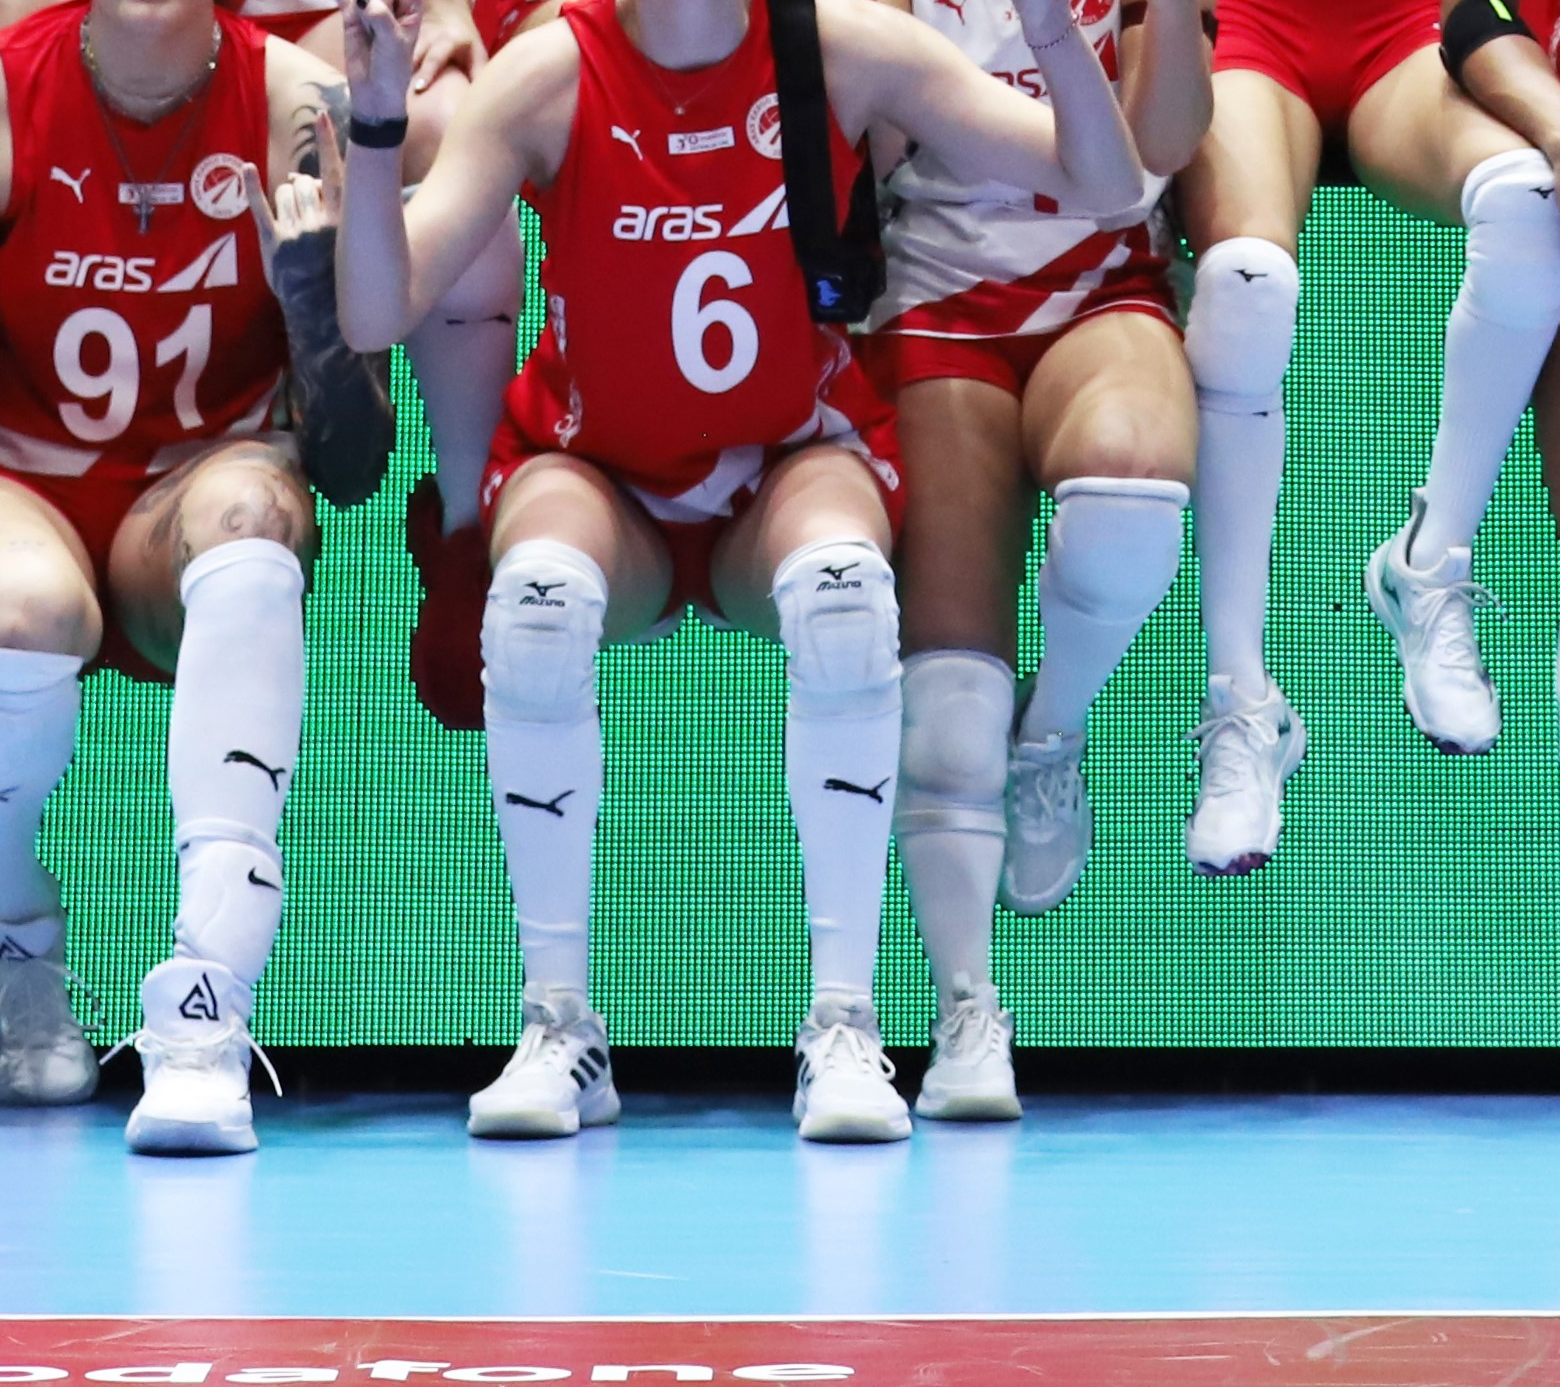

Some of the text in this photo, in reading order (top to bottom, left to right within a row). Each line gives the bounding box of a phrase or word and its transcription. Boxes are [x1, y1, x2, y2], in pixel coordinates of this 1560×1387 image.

[613, 205, 723, 241] aras
[45, 251, 156, 292] aras
[671, 250, 759, 393] 6
[54, 304, 212, 441] 91
